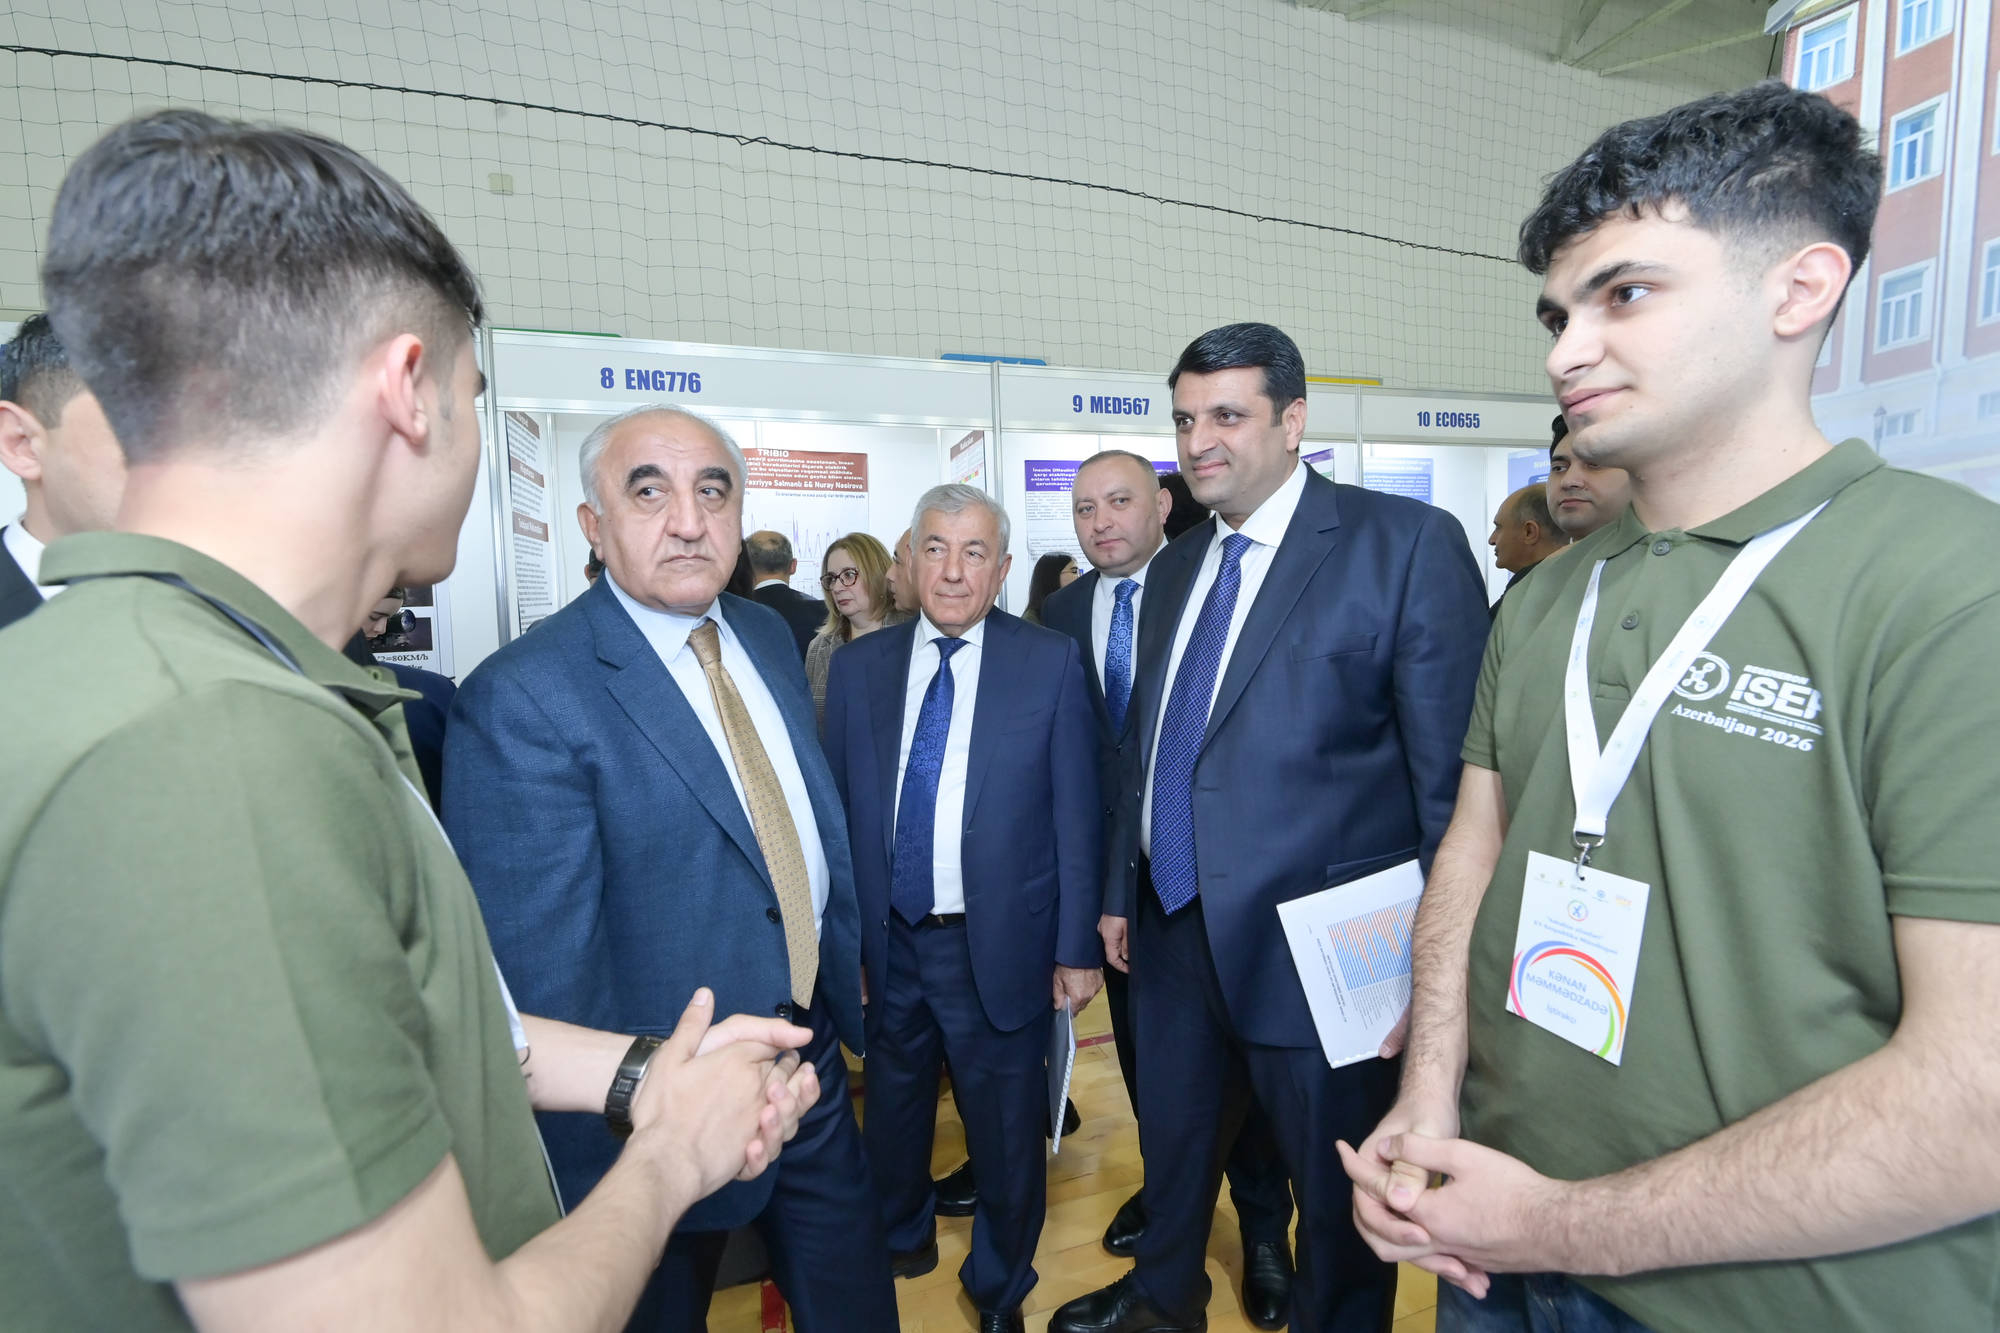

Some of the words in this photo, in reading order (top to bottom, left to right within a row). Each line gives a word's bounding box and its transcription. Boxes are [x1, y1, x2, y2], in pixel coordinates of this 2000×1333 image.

[601, 367, 614, 389] 8
[625, 369, 701, 393] ENG776
[1073, 395, 1083, 413] 9
[1090, 396, 1150, 415] MED567
[1417, 411, 1430, 427] 10
[757, 448, 789, 458] TRIBIO
[1670, 703, 1758, 738] Azerbaijan
[1759, 727, 1815, 752] 2026
